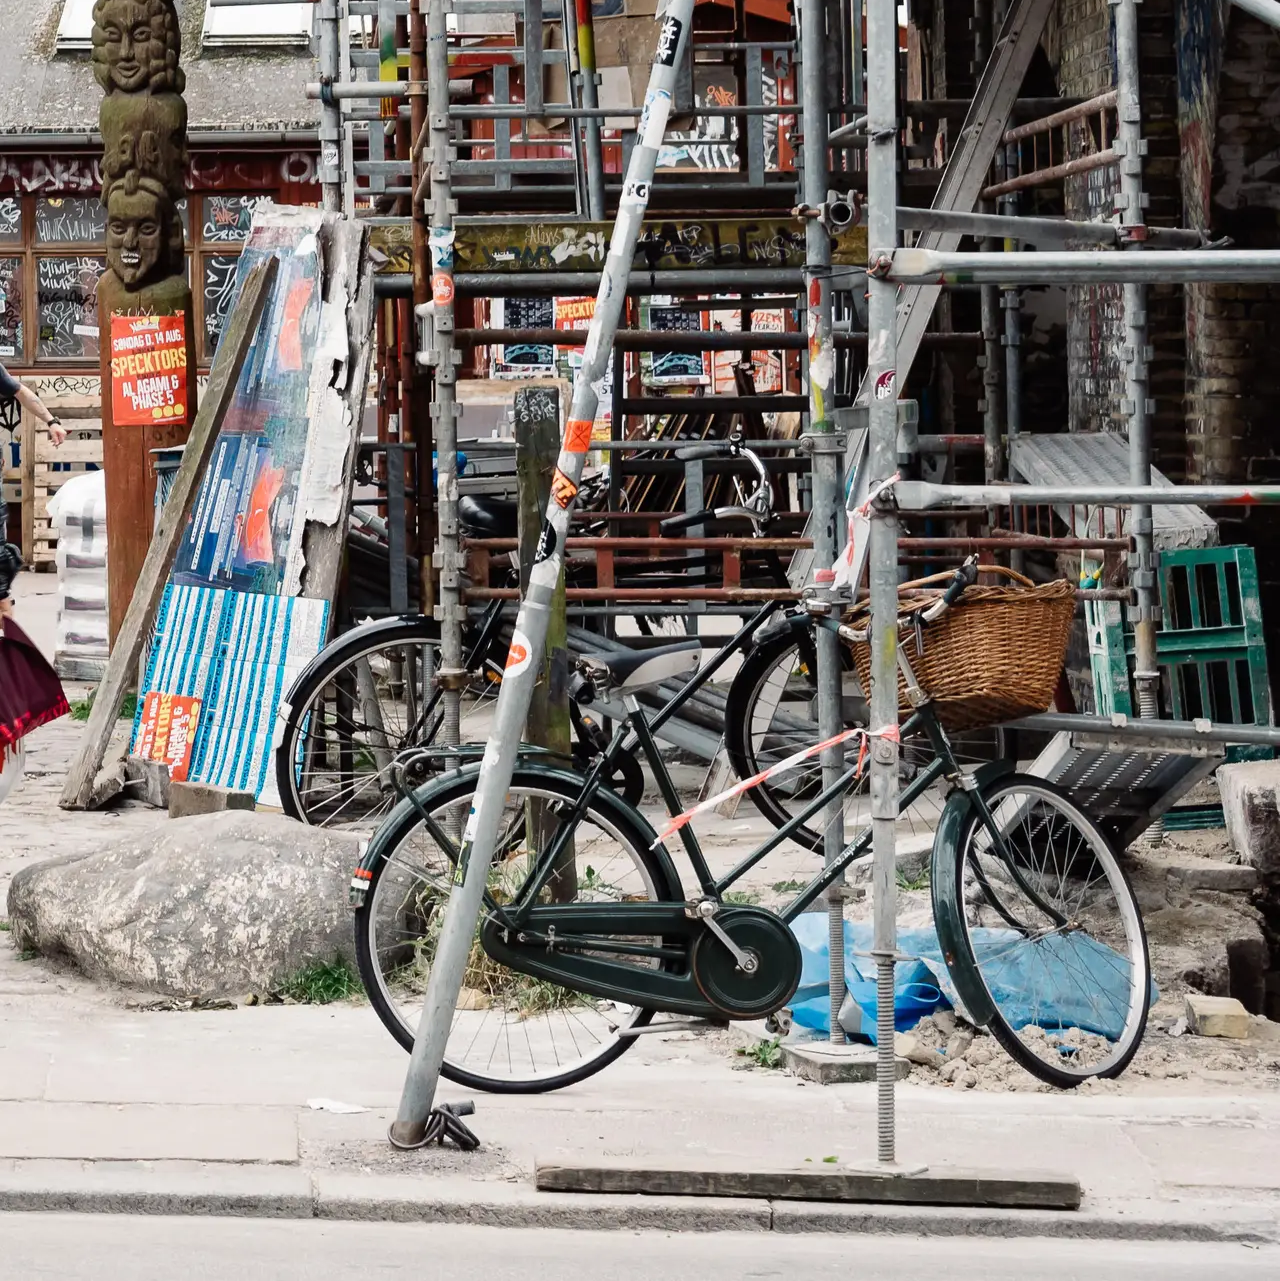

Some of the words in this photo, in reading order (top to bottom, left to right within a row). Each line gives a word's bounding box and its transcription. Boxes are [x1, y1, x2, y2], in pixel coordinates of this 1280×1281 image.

[113, 334, 144, 352] SØNDAG
[144, 333, 154, 346] D.
[154, 332, 164, 344] 14
[165, 329, 184, 343] AUG.
[111, 347, 187, 378] SPECKTORS
[122, 381, 134, 398] AL
[137, 376, 170, 396] AGAMI
[171, 374, 179, 390] &
[131, 391, 165, 410] PHASE
[166, 390, 175, 405] 5
[157, 584, 173, 634] LOPPEN
[224, 593, 237, 641] LOPPEN
[142, 648, 158, 699] LOPPEN
[209, 659, 224, 707] LOPPEN
[147, 719, 155, 730] 14
[149, 694, 158, 718] AUG.
[130, 711, 143, 755] OPPEN
[167, 717, 182, 758] AGAMI
[172, 725, 189, 767] PHASE
[181, 714, 190, 724] 5
[194, 722, 210, 775] LOPPEN
